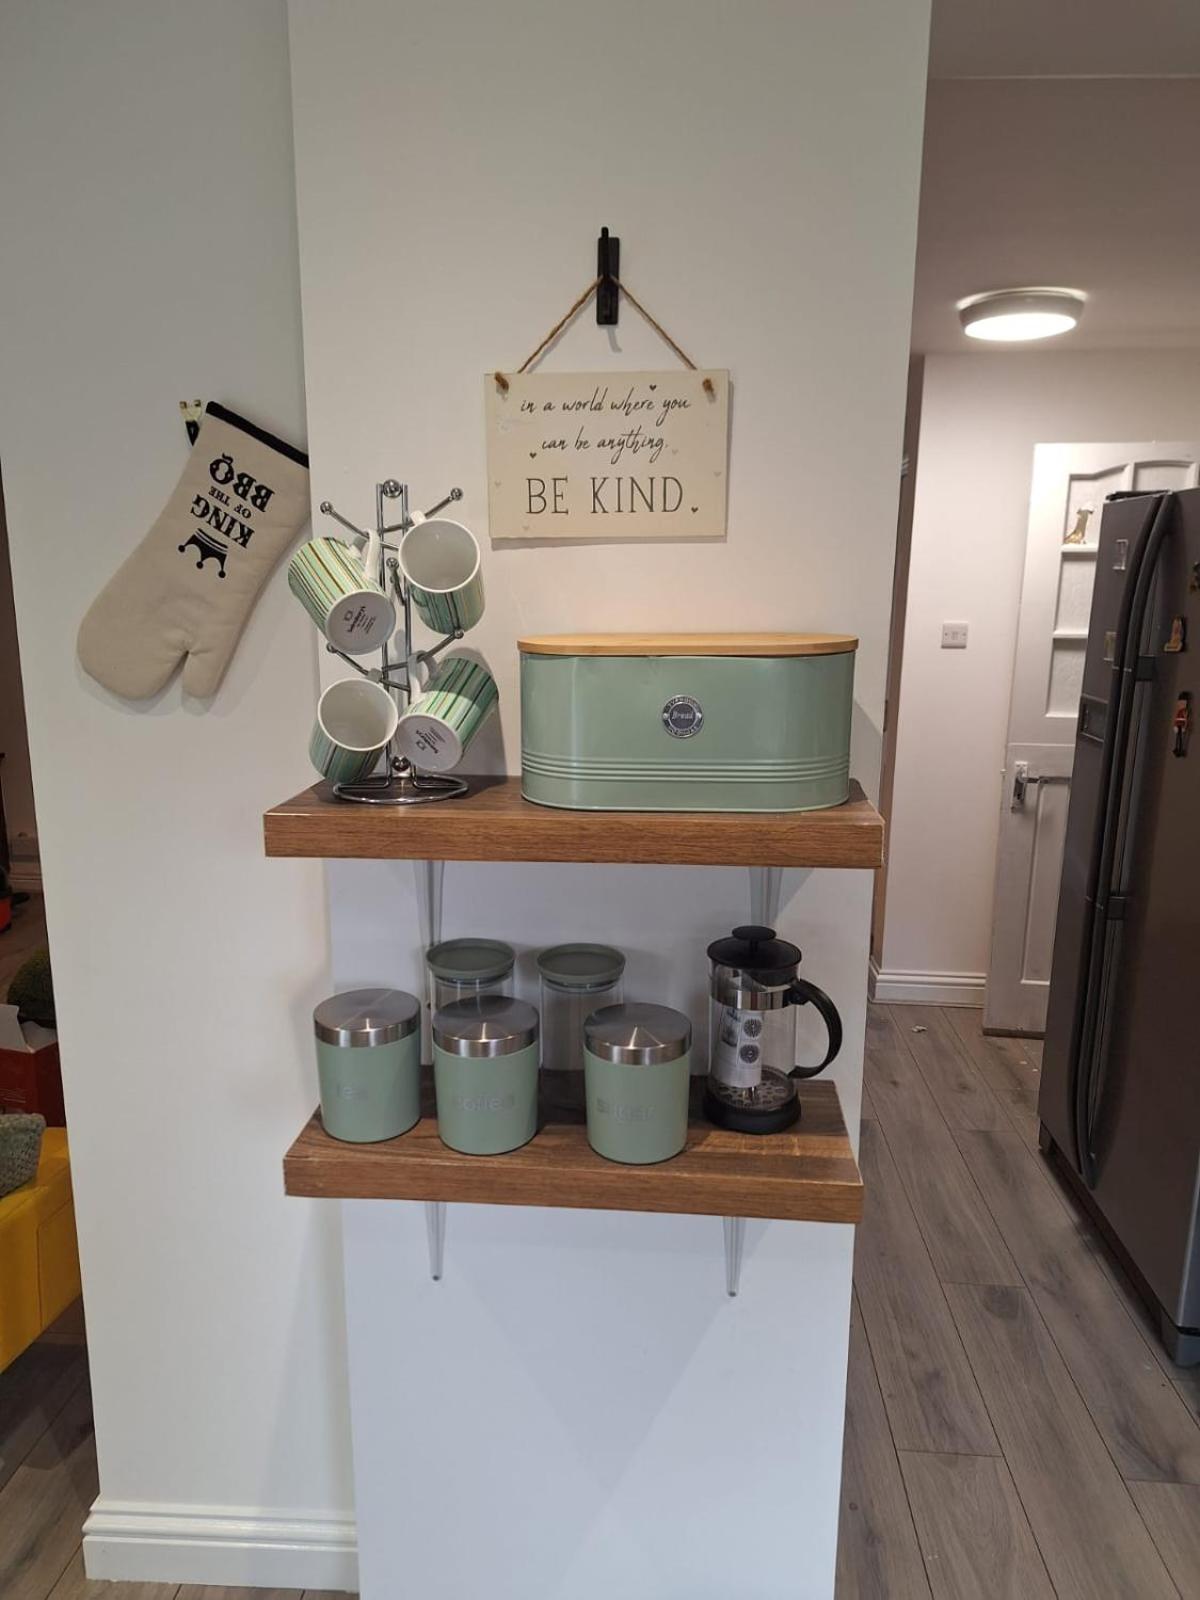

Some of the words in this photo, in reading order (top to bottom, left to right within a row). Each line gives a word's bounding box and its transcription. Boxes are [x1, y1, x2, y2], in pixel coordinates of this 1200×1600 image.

[520, 399, 536, 412] in
[543, 402, 556, 412] a
[562, 386, 608, 413] world
[610, 386, 656, 416] where
[655, 399, 692, 427] you
[541, 439, 567, 450] can
[574, 425, 590, 450] be
[208, 486, 230, 507] THE
[209, 452, 275, 513] BBQ
[526, 475, 569, 515] BE
[590, 476, 684, 514] KIND
[190, 494, 255, 549] KING
[233, 503, 252, 519] OF
